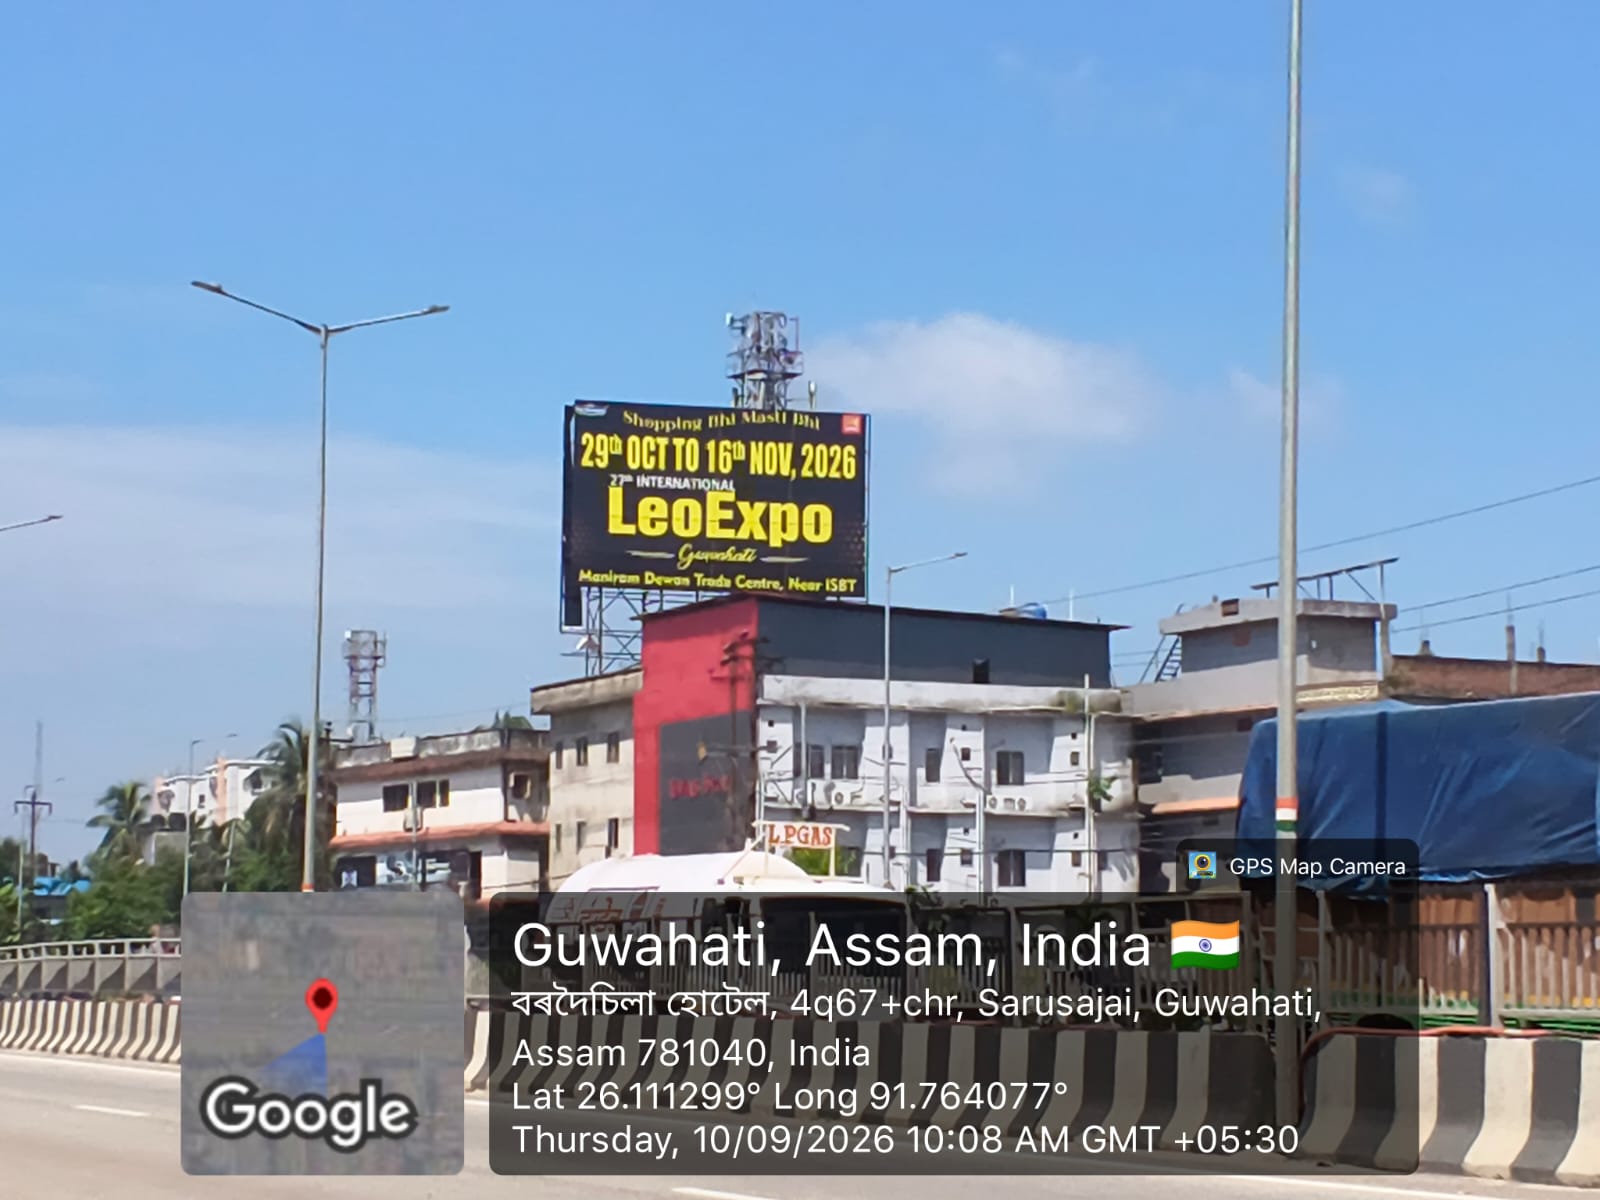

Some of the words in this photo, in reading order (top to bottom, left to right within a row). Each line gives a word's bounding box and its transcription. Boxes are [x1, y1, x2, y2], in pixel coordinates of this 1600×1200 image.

[622, 410, 702, 432] Shopping
[708, 412, 736, 428] Bhi
[741, 411, 787, 425] Masti
[793, 412, 820, 430] Bhi
[581, 432, 623, 469] 29th
[626, 435, 669, 471] OCT
[671, 436, 700, 473] TO
[706, 439, 746, 474] 16th
[749, 441, 796, 481] NOV,
[801, 443, 857, 480] 2026
[609, 474, 634, 487] 27th
[636, 475, 736, 492] INTERNATIONAL
[608, 486, 833, 548] LeoExpo
[676, 543, 757, 570] Guwahati
[578, 569, 640, 586] Maniram
[644, 571, 690, 587] Dewan
[693, 573, 732, 588] Trade
[735, 575, 784, 592] Centre,
[788, 577, 821, 592] Near
[825, 579, 858, 593] ISBT
